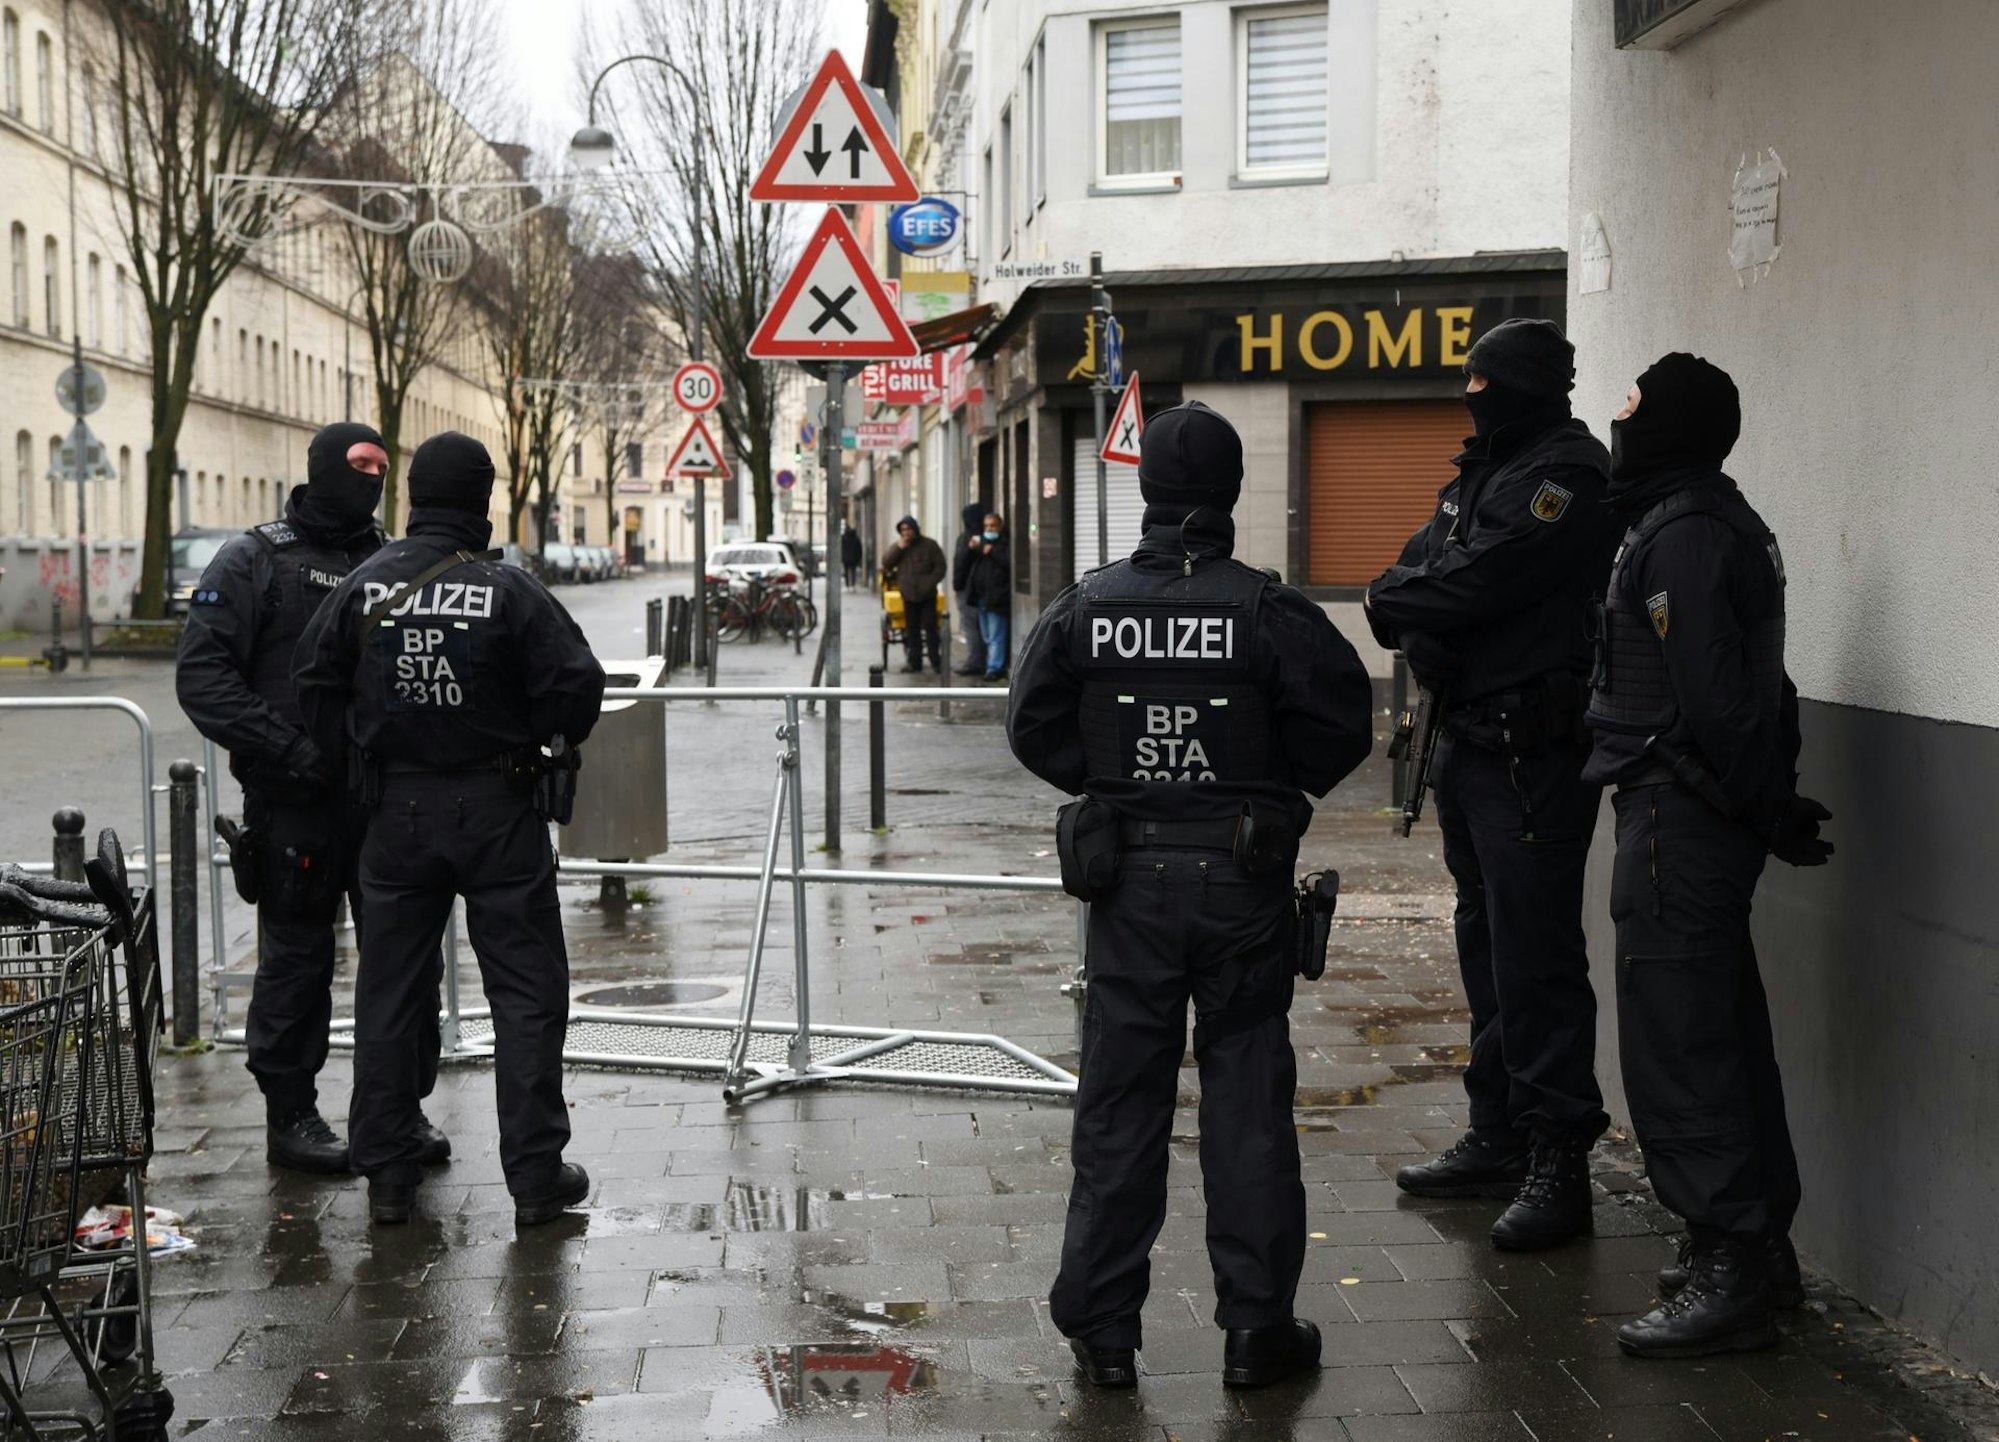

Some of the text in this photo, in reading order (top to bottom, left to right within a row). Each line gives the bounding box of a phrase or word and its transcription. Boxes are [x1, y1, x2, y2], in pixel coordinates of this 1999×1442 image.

[903, 217, 953, 237] EFES
[995, 261, 1083, 278] Holweider Str.
[1236, 306, 1474, 373] HOME
[682, 377, 711, 400] 30
[888, 374, 935, 392] GRILL
[362, 582, 494, 618] POLIZEI
[403, 628, 445, 653] BP
[1092, 616, 1233, 659] POLIZEI
[396, 655, 456, 681] STA
[1146, 705, 1198, 735] BP
[1136, 737, 1210, 768] STA
